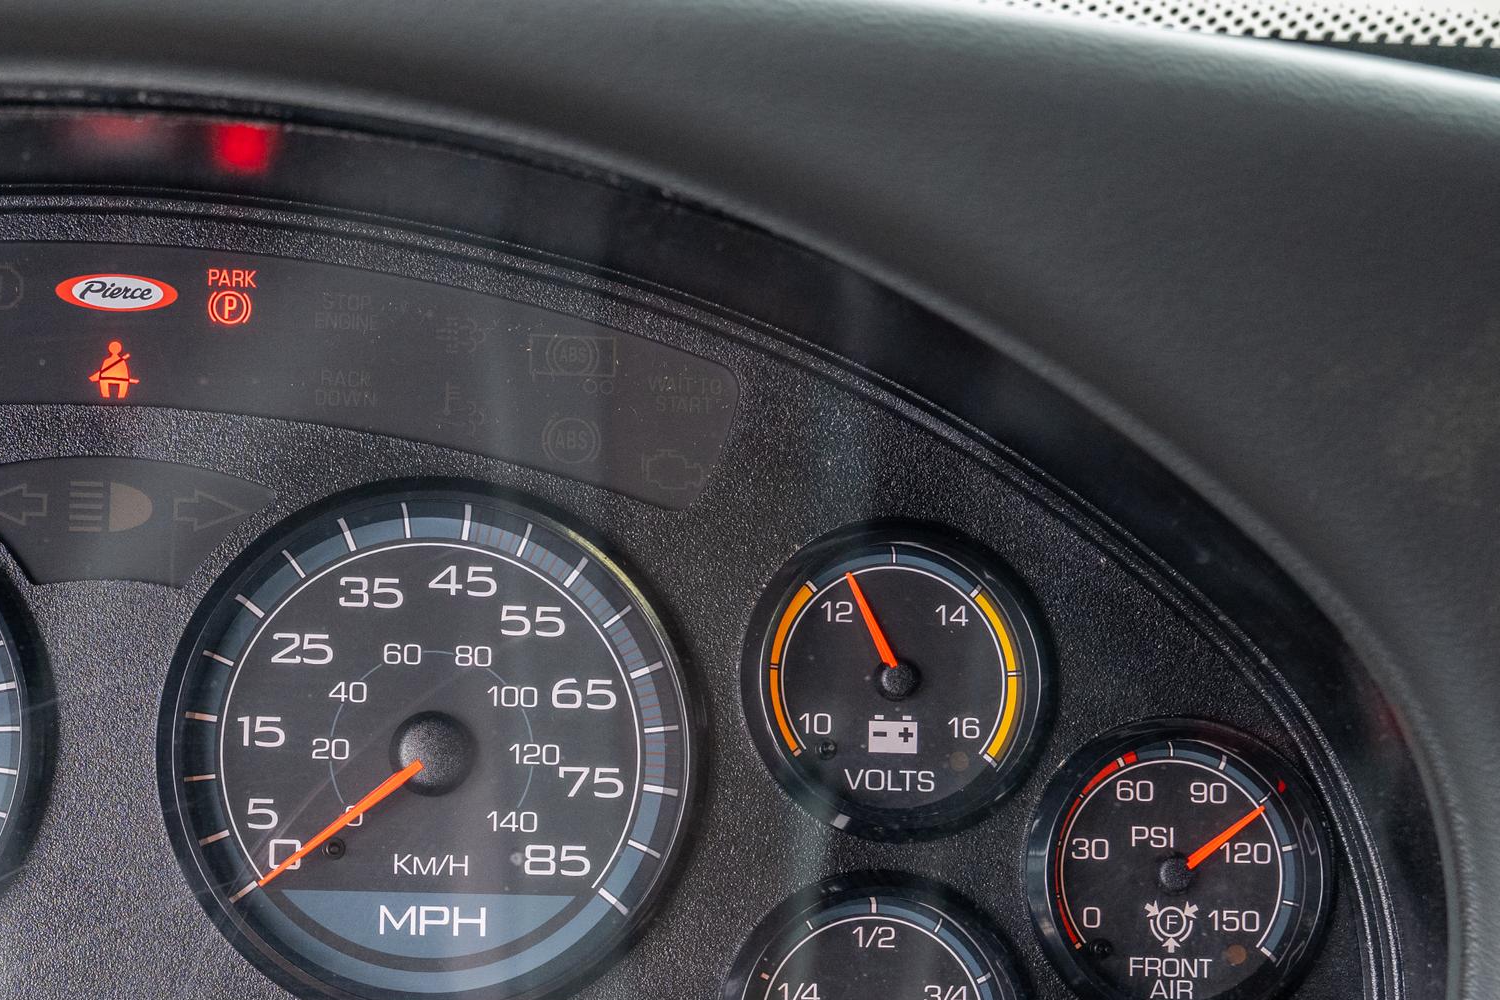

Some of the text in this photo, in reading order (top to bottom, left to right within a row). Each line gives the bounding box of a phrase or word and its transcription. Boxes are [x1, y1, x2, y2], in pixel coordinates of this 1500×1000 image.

[208, 269, 257, 288] PARK
[79, 280, 153, 300] Pierce
[555, 430, 588, 451] ABS
[338, 577, 404, 609] 35
[428, 566, 498, 598] 45
[499, 605, 566, 637] 55
[820, 601, 853, 623] 12
[935, 605, 969, 626] 14
[271, 633, 334, 665] 25
[383, 644, 422, 665] 60
[454, 645, 493, 667] 80
[328, 682, 368, 703] 40
[486, 686, 539, 708] 100
[550, 679, 618, 710] 65
[236, 715, 286, 748] 15
[799, 713, 832, 735] 10
[948, 717, 980, 739] 16
[311, 738, 350, 760] 20
[508, 743, 560, 766] 120
[557, 767, 625, 799] 75
[844, 769, 935, 792] VOLTS
[1116, 780, 1154, 802] 60
[1190, 782, 1227, 804] 90
[246, 798, 279, 830] 5
[486, 810, 539, 833] 140
[1131, 826, 1175, 848] PSI
[268, 839, 302, 871] 0
[1071, 838, 1109, 860] 30
[1219, 842, 1272, 864] 120
[523, 845, 591, 877] 85
[379, 905, 487, 937] MPH
[1083, 907, 1101, 928] 0
[1208, 910, 1260, 932] 150
[852, 926, 896, 949] 1/2
[1129, 957, 1213, 979] FRONT
[1150, 980, 1194, 1000] AIR
